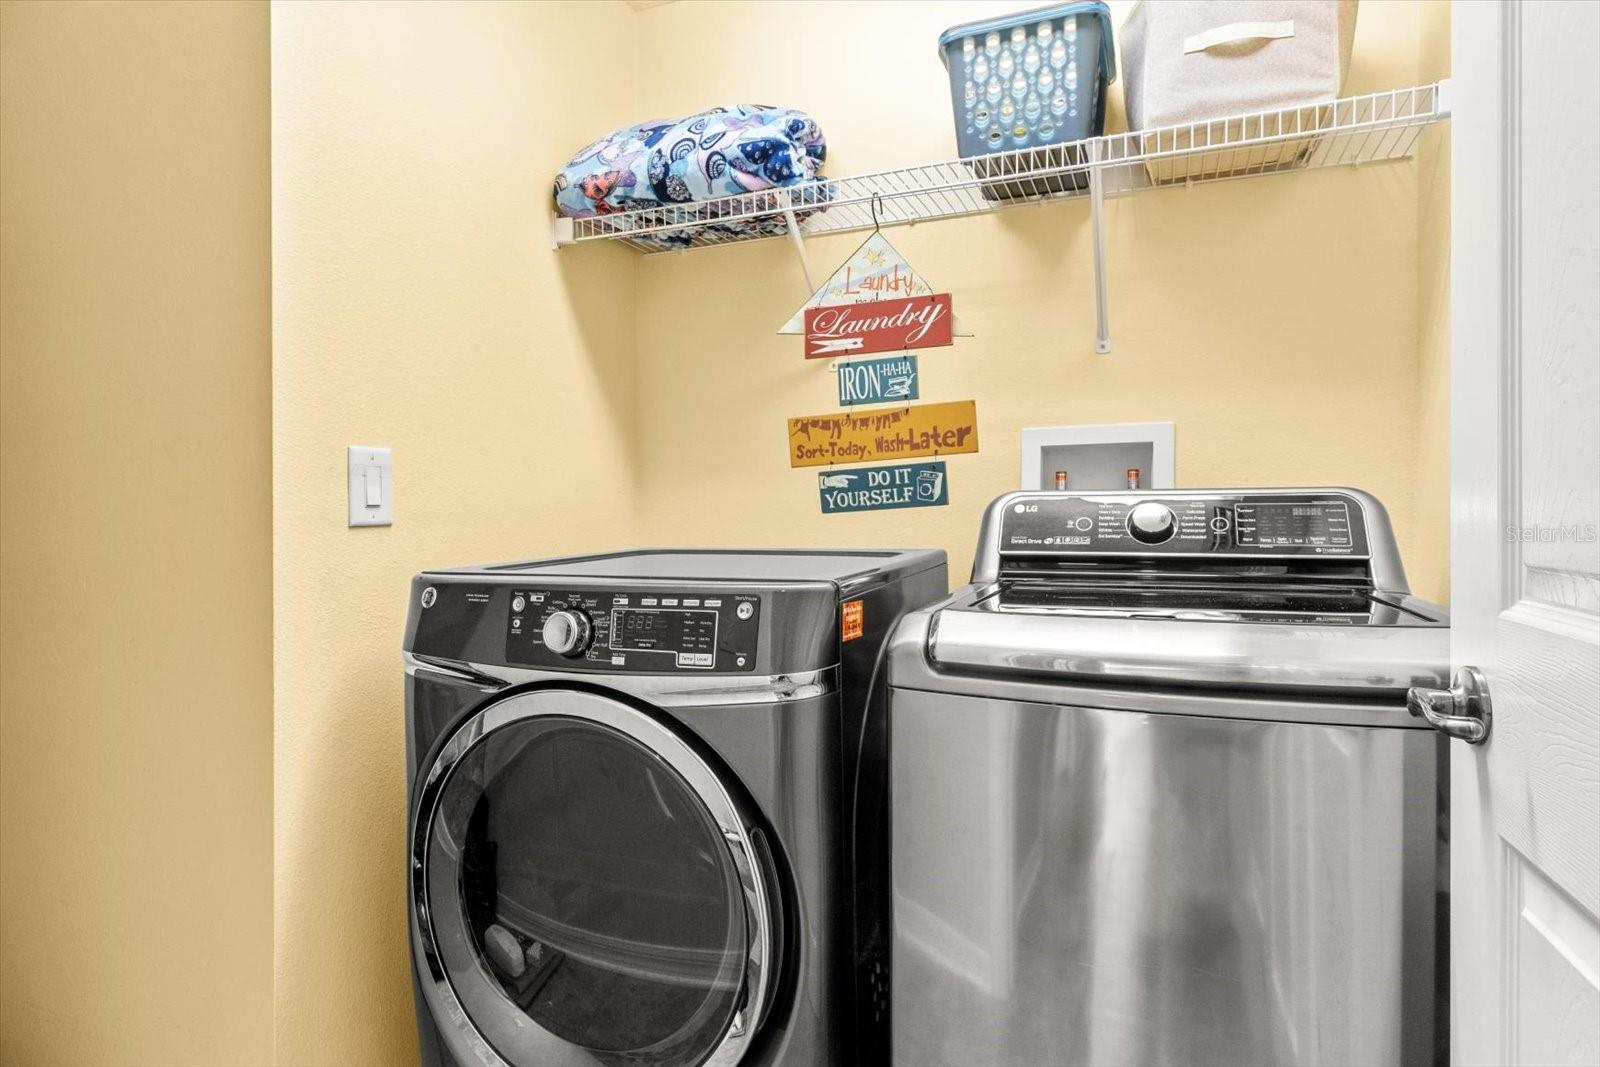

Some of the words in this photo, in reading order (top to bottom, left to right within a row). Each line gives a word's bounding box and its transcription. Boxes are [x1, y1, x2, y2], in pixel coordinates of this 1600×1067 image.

[843, 265, 914, 296] Laundry
[808, 303, 948, 344] Laundry
[868, 470, 890, 487] DO
[895, 467, 912, 485] IT
[825, 487, 913, 509] YOURSELF
[1025, 505, 1038, 513] LG
